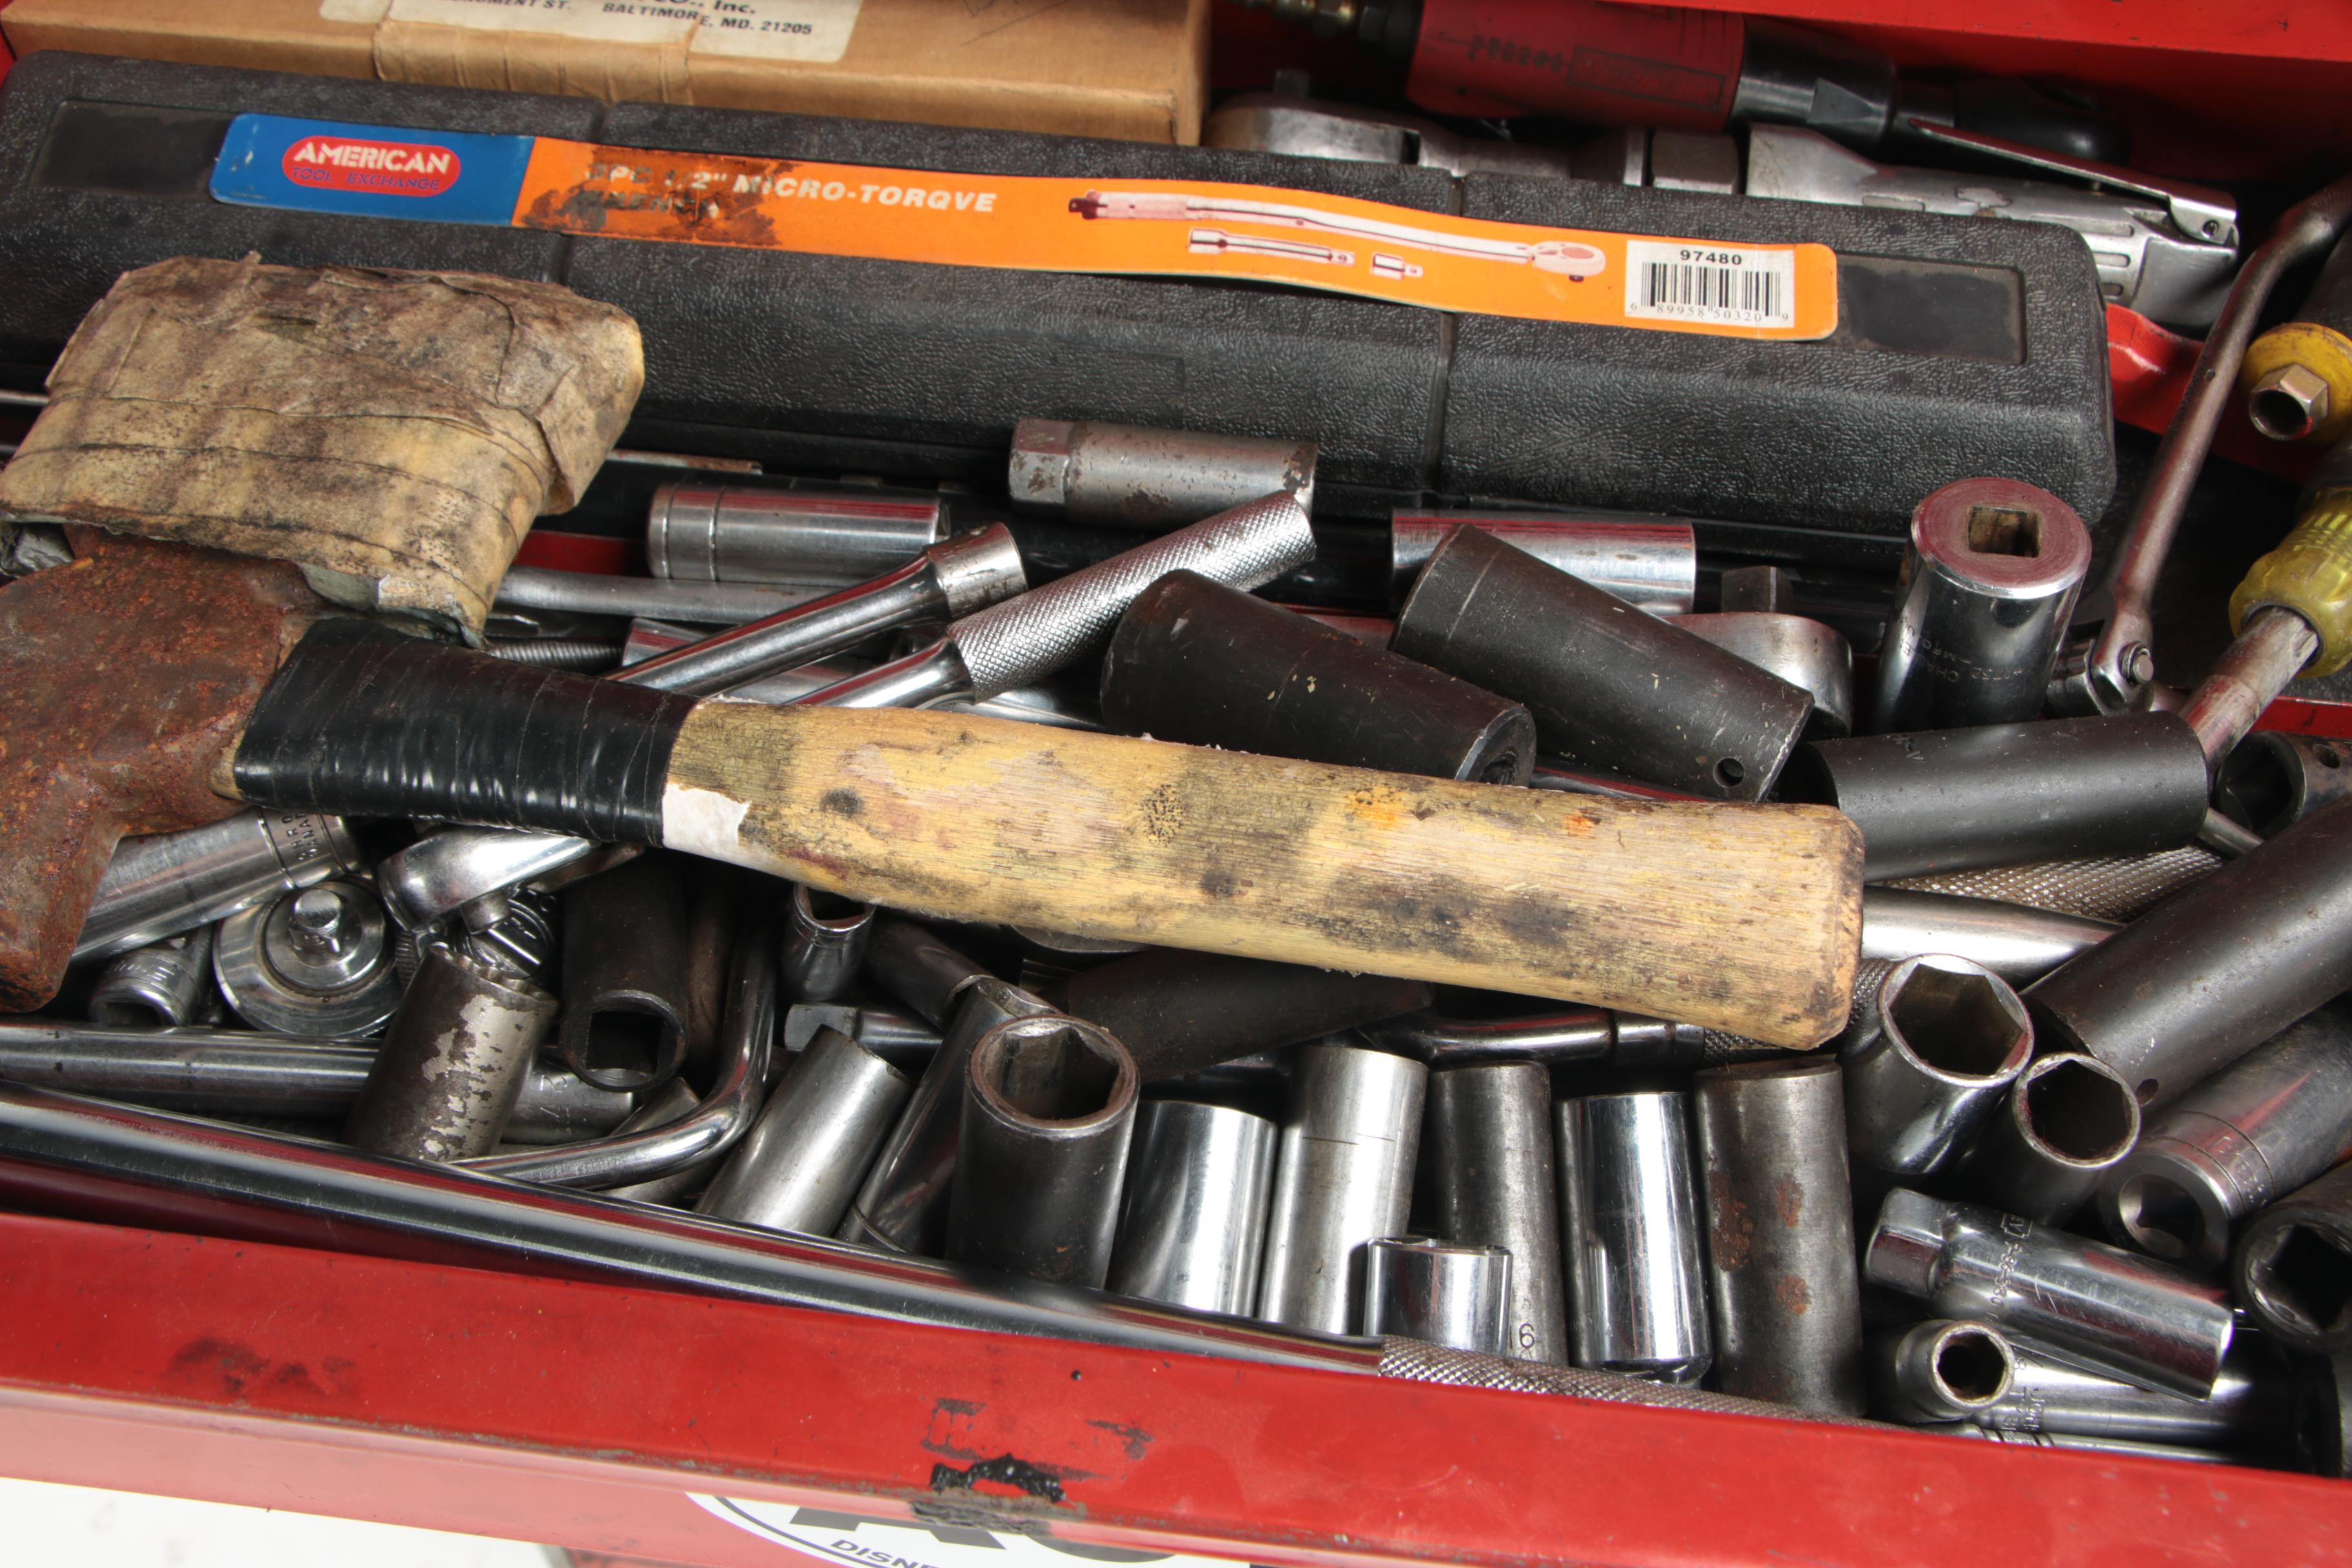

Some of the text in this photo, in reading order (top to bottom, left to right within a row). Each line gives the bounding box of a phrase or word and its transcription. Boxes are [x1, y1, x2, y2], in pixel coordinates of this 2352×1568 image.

[543, 0, 571, 10] ST.
[721, 17, 754, 30] MD.
[761, 21, 813, 34] 21205
[714, 0, 756, 14] Inc.
[293, 141, 451, 175] AMERICAN
[292, 167, 440, 190] TOOL EXCHANGE
[1680, 249, 1743, 266] 97480
[1656, 304, 1705, 318] 89958
[1713, 309, 1761, 322] 50320
[830, 1539, 939, 1568] DISN
